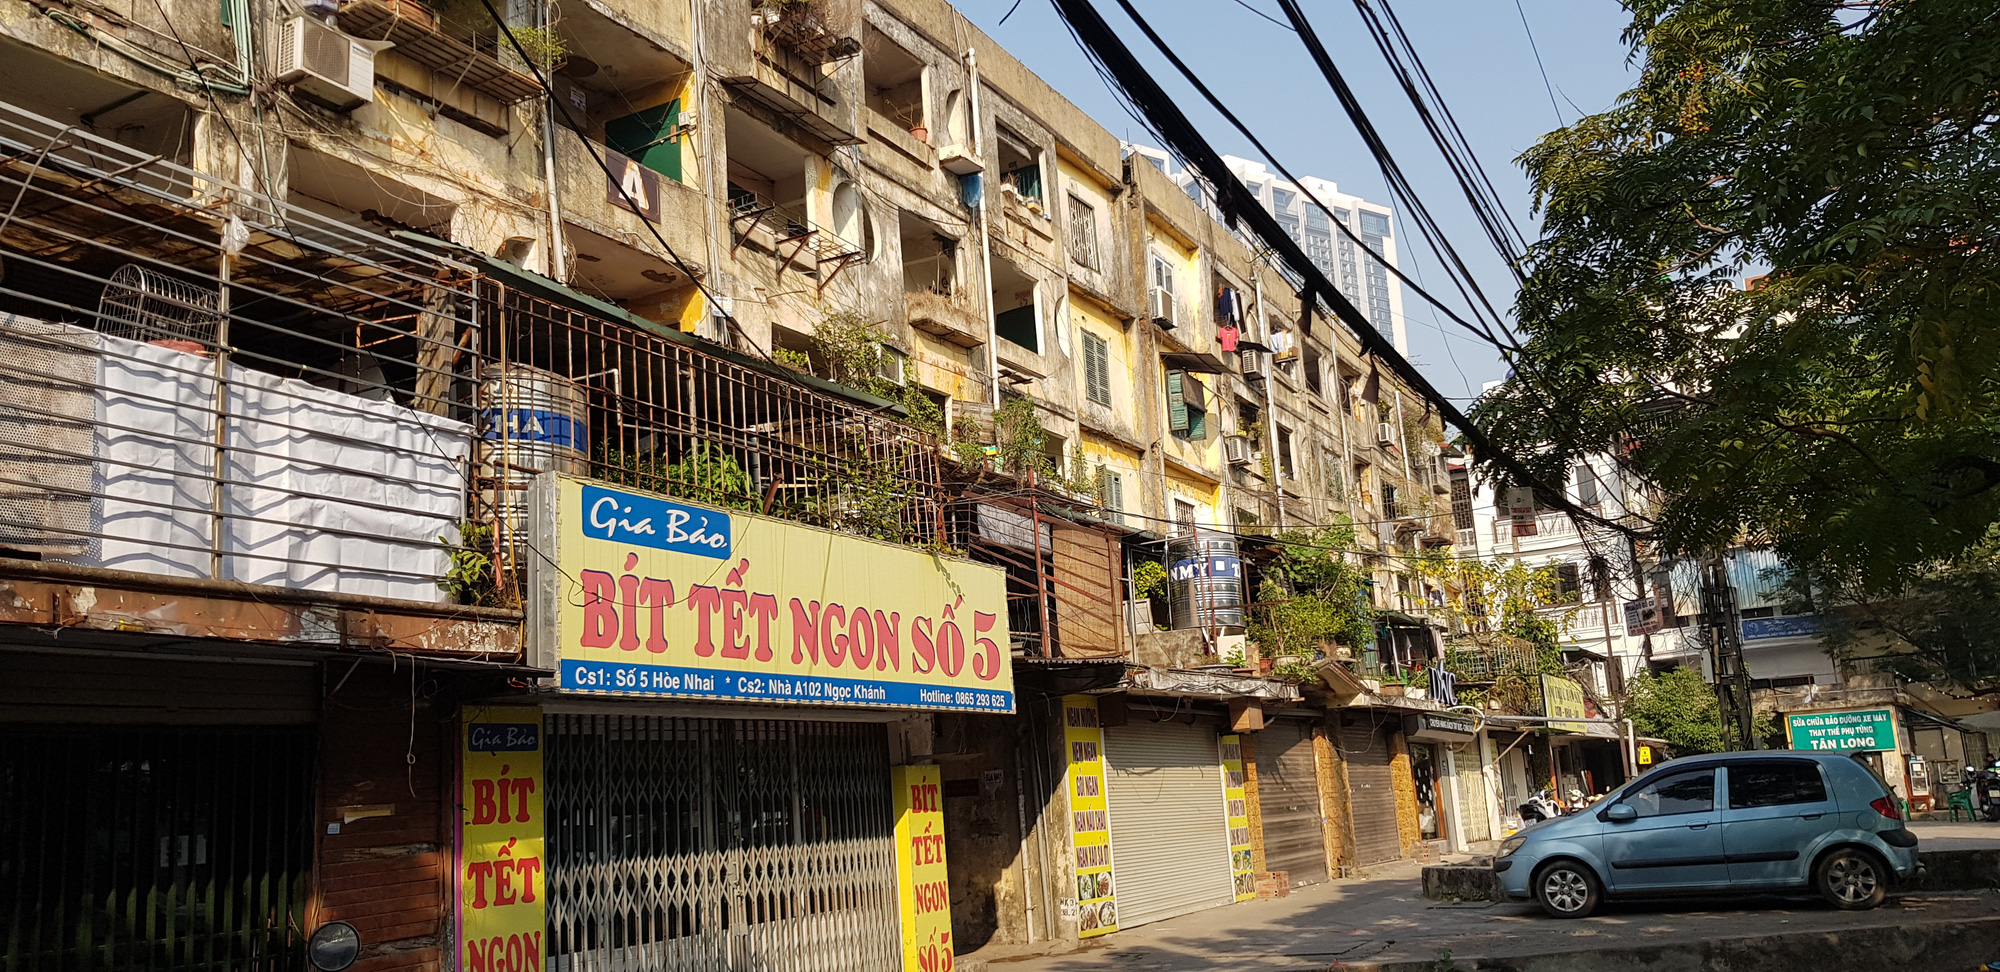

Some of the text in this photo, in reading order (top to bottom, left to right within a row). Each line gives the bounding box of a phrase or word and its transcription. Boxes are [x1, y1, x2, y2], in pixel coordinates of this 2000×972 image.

[619, 159, 650, 210] A
[590, 496, 656, 538] Gia
[580, 552, 1001, 681] BÍT TẾT NGON SỐ 5
[575, 666, 715, 691] Cs1: Số 5 Hòe Nhai
[737, 676, 886, 701] Cs2: Nhà A102 Ngọc Khánh
[920, 688, 1006, 708] Hotline: 0865 293 625
[471, 727, 501, 749] Gia
[1792, 712, 1887, 727] SỬA CHỮA BẢO DƯỠNG XE MÁY
[1809, 724, 1874, 737] THAY THẾ PHỤ TÙNG
[1810, 736, 1876, 750] TÂN LONG
[471, 764, 535, 825] BÍT
[910, 775, 938, 814] BÍT
[912, 821, 943, 866] TẾT
[467, 837, 541, 910] TẾT
[914, 880, 948, 915] NGON
[468, 931, 541, 972] NGON
[919, 926, 953, 972] SỐ 5
